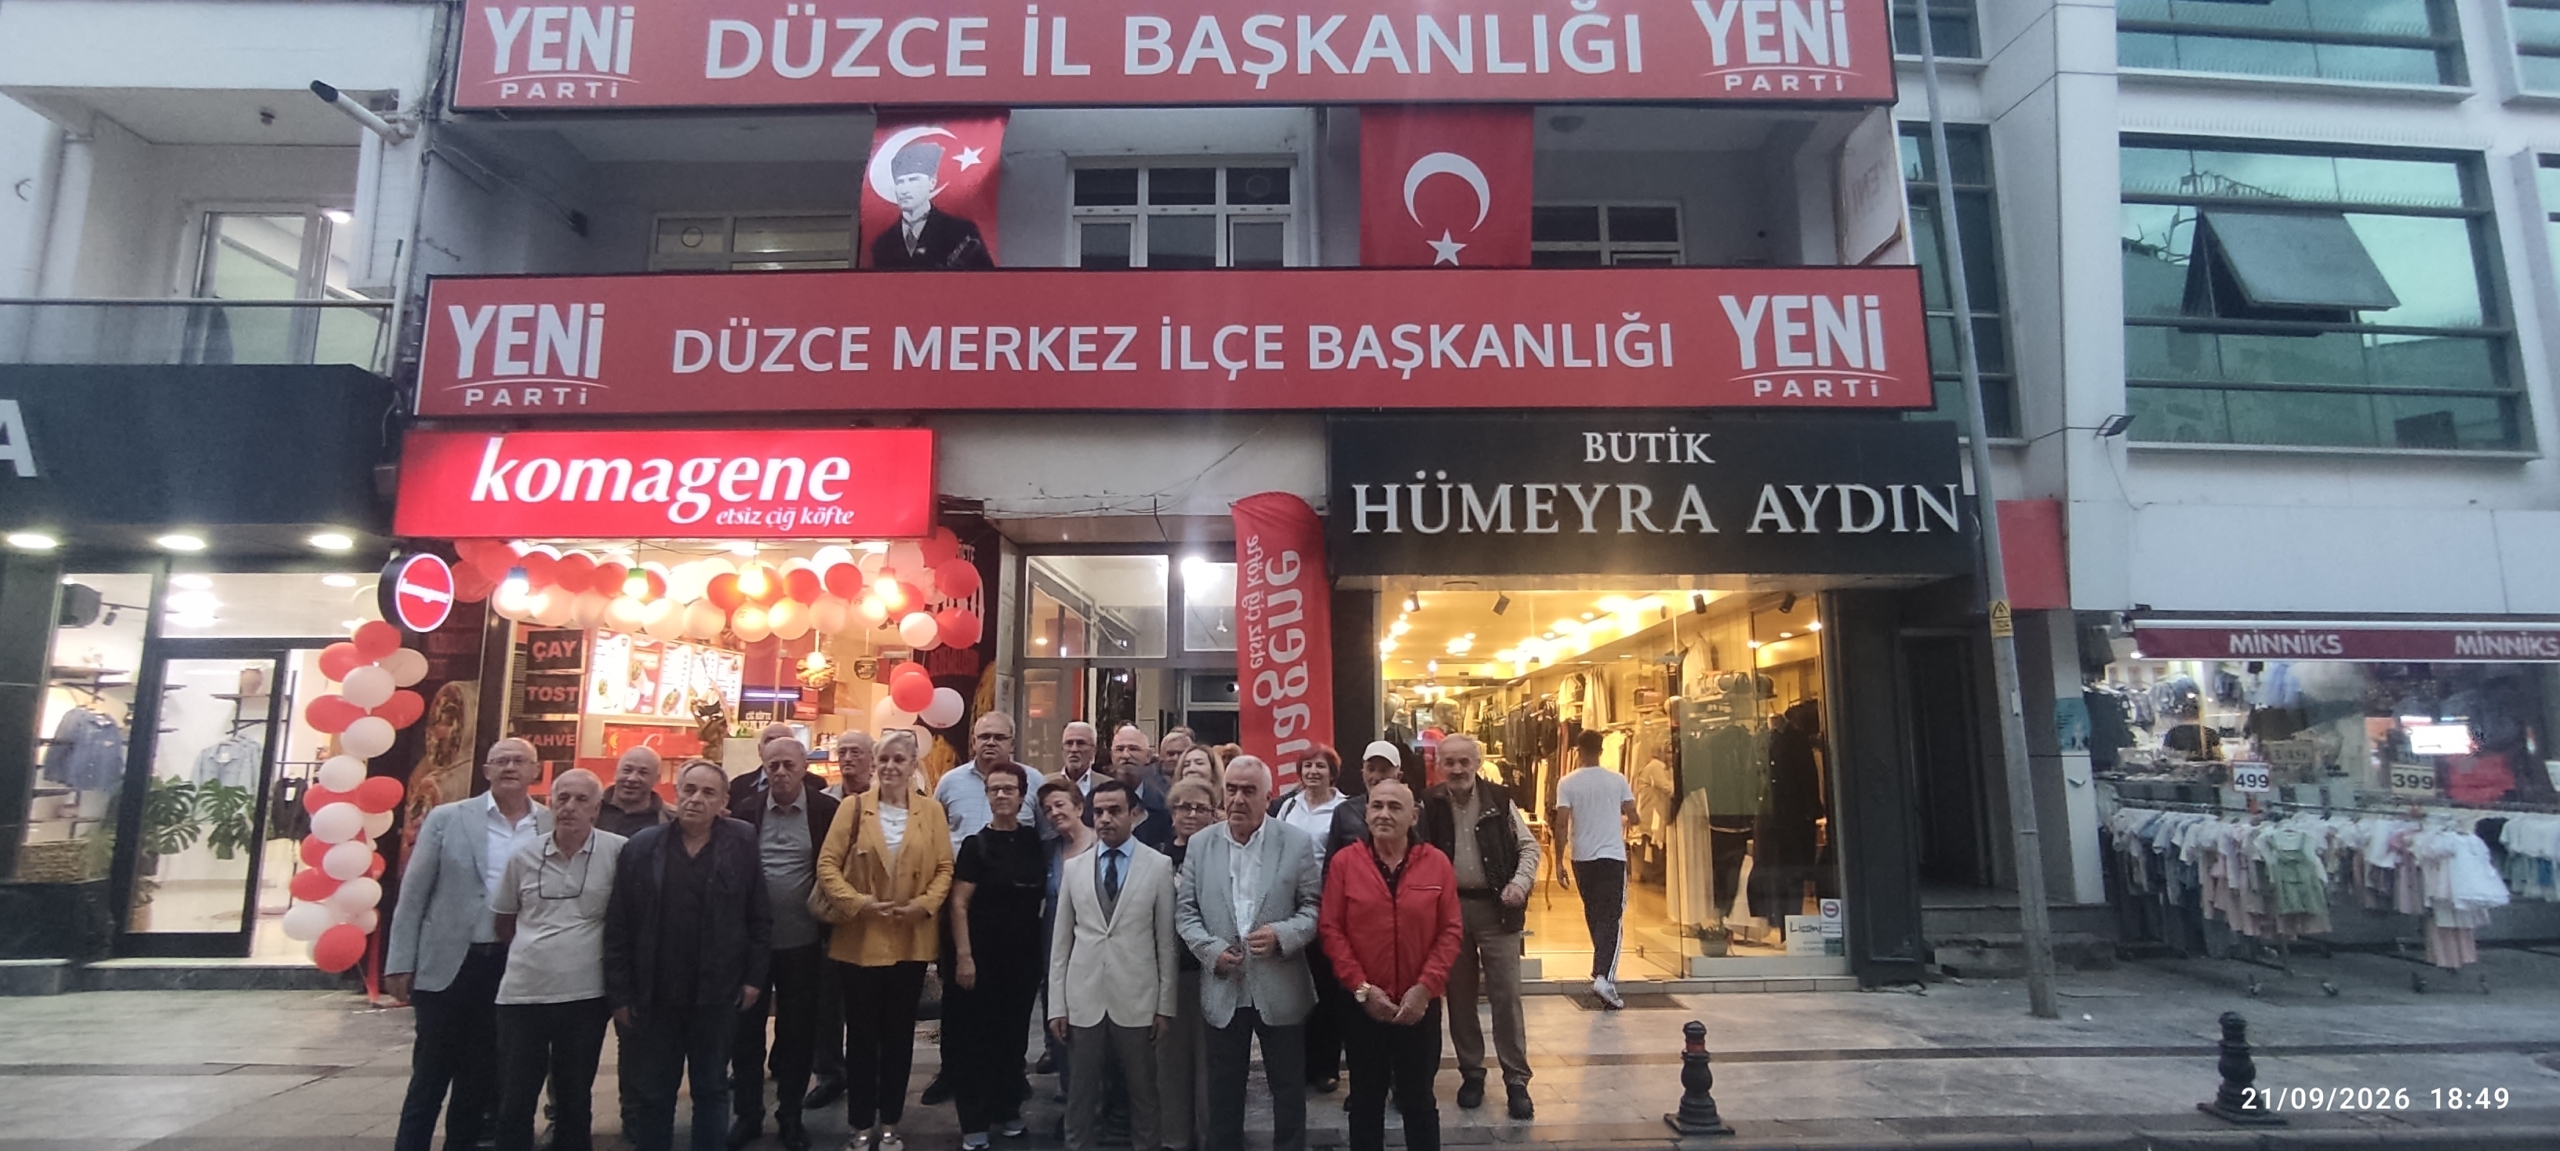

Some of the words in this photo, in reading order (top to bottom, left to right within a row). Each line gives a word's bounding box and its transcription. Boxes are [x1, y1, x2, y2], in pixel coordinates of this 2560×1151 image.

[705, 3, 989, 79] DÜZCE
[1023, 4, 1091, 76] İL
[1124, 0, 1643, 90] BAŞKANLIĞI
[672, 317, 871, 374] DÜZCE
[893, 326, 1138, 372] MERKEZ
[1160, 315, 1284, 381] İLÇE
[1308, 311, 1673, 380] BAŞKANLIĞI
[1582, 425, 1716, 464] BUTİK
[470, 437, 851, 524] komagene
[1351, 470, 1720, 534] HÜMEYRA
[1746, 483, 1960, 533] AYDIN
[716, 507, 762, 526] etsiz
[765, 506, 796, 532] çiğ
[800, 505, 855, 528] köfte
[532, 640, 577, 663] ÇAY
[527, 686, 578, 702] TOST
[521, 733, 576, 747] KAHVE
[2235, 773, 2269, 788] 499
[2391, 773, 2434, 790] 399
